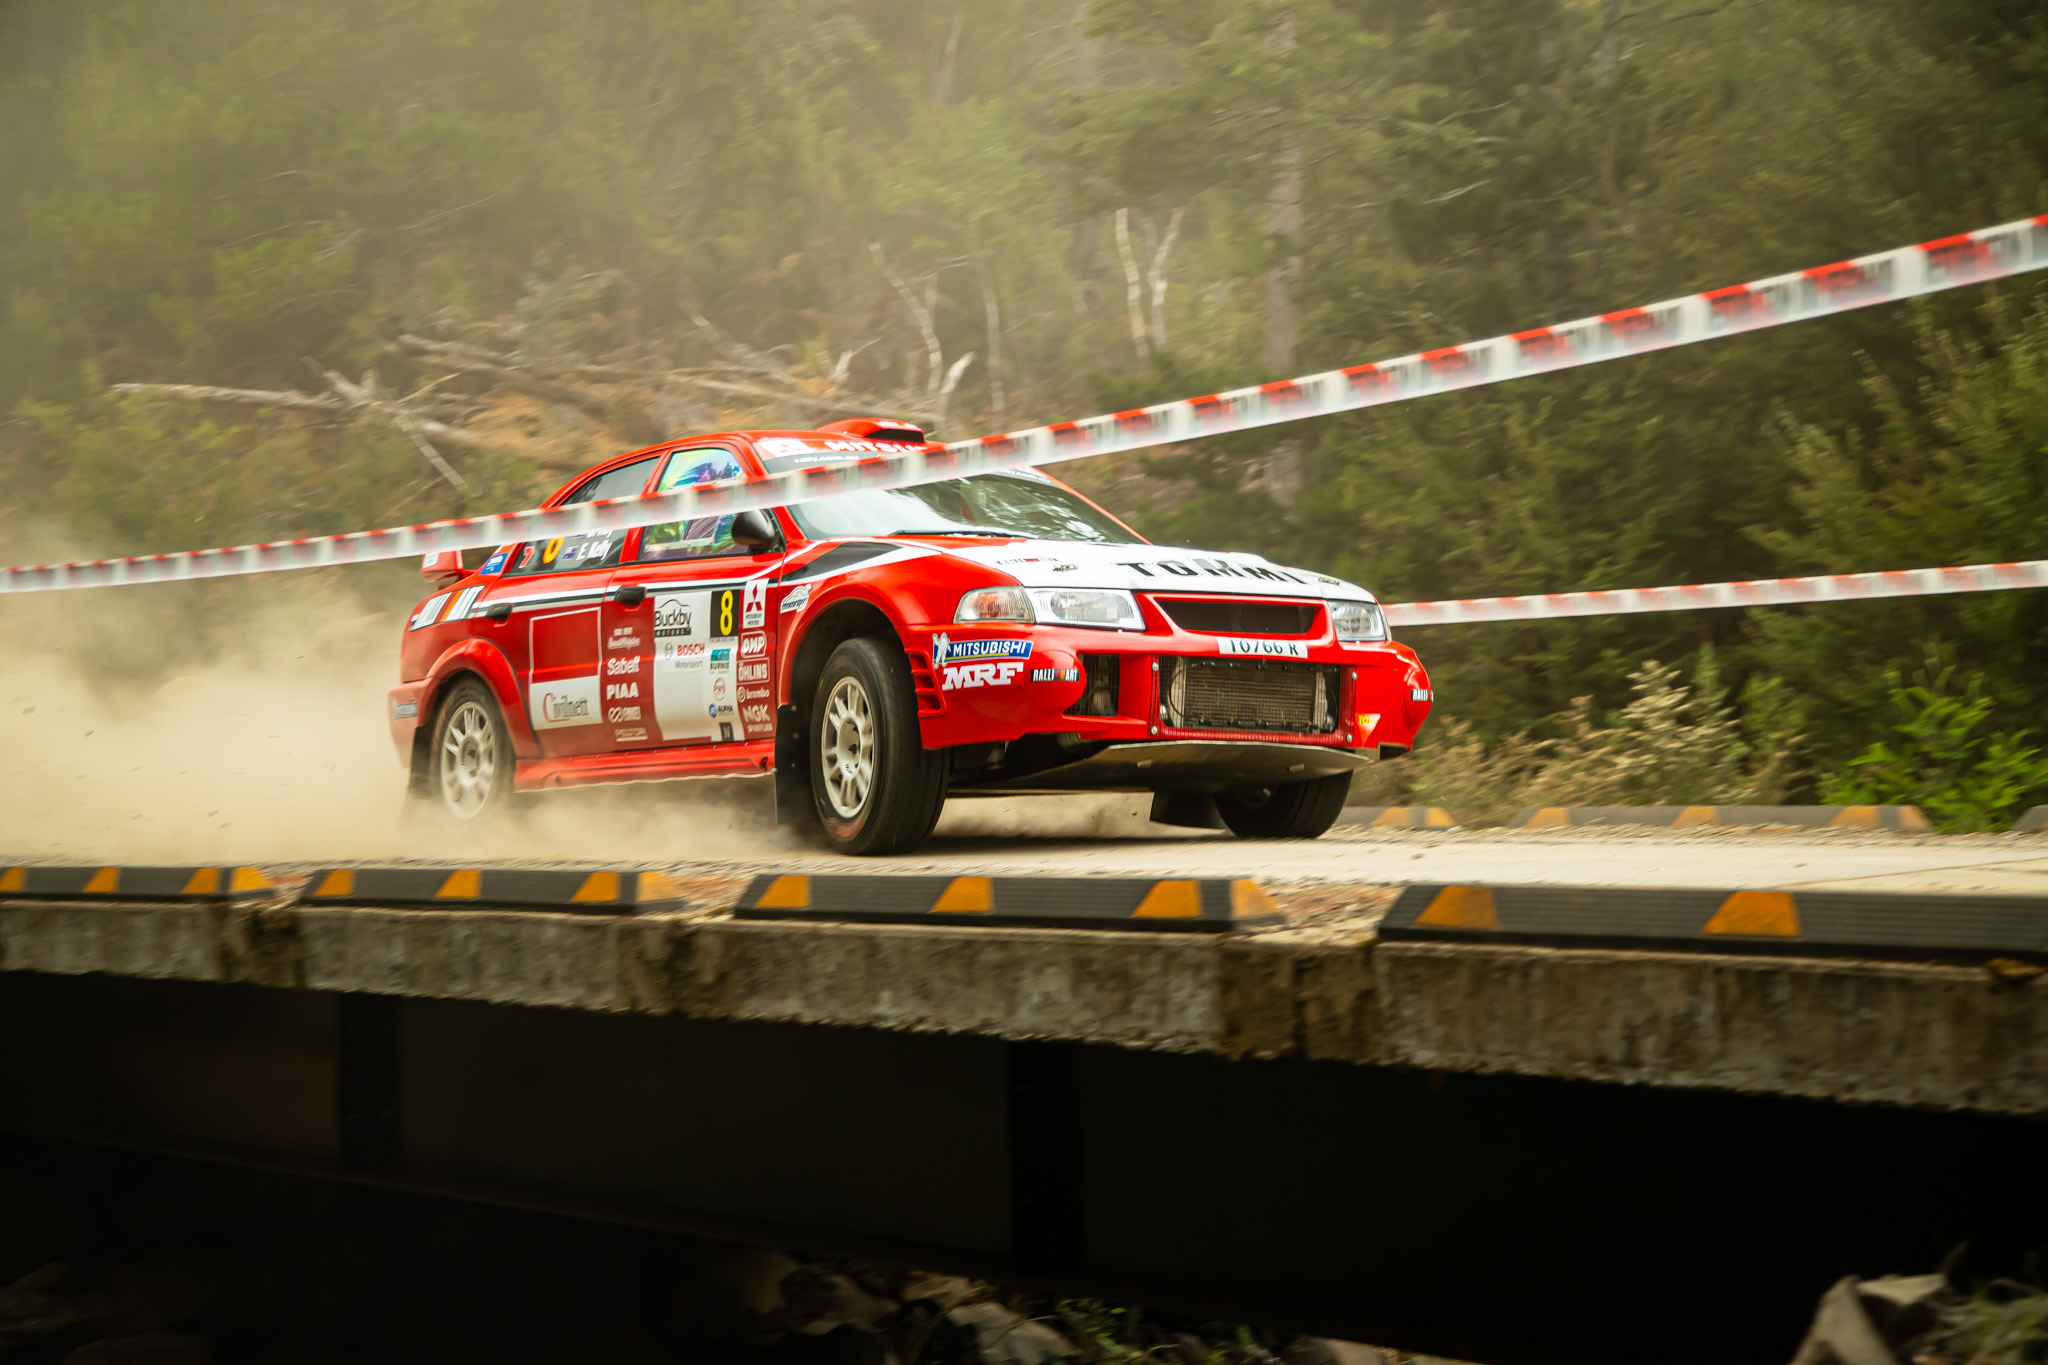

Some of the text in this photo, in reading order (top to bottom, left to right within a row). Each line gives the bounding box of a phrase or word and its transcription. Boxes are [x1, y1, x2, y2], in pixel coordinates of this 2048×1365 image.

[655, 608, 692, 629] Buckby
[720, 590, 733, 636] 8
[677, 643, 705, 656] BOSCH
[741, 635, 765, 655] OMP
[953, 641, 1026, 657] MITSUBISHI
[738, 661, 768, 681] ÖHLINS
[942, 662, 1024, 691] MRF
[606, 681, 640, 701] PIAA
[746, 686, 770, 699] brembo
[742, 704, 771, 723] NGK
